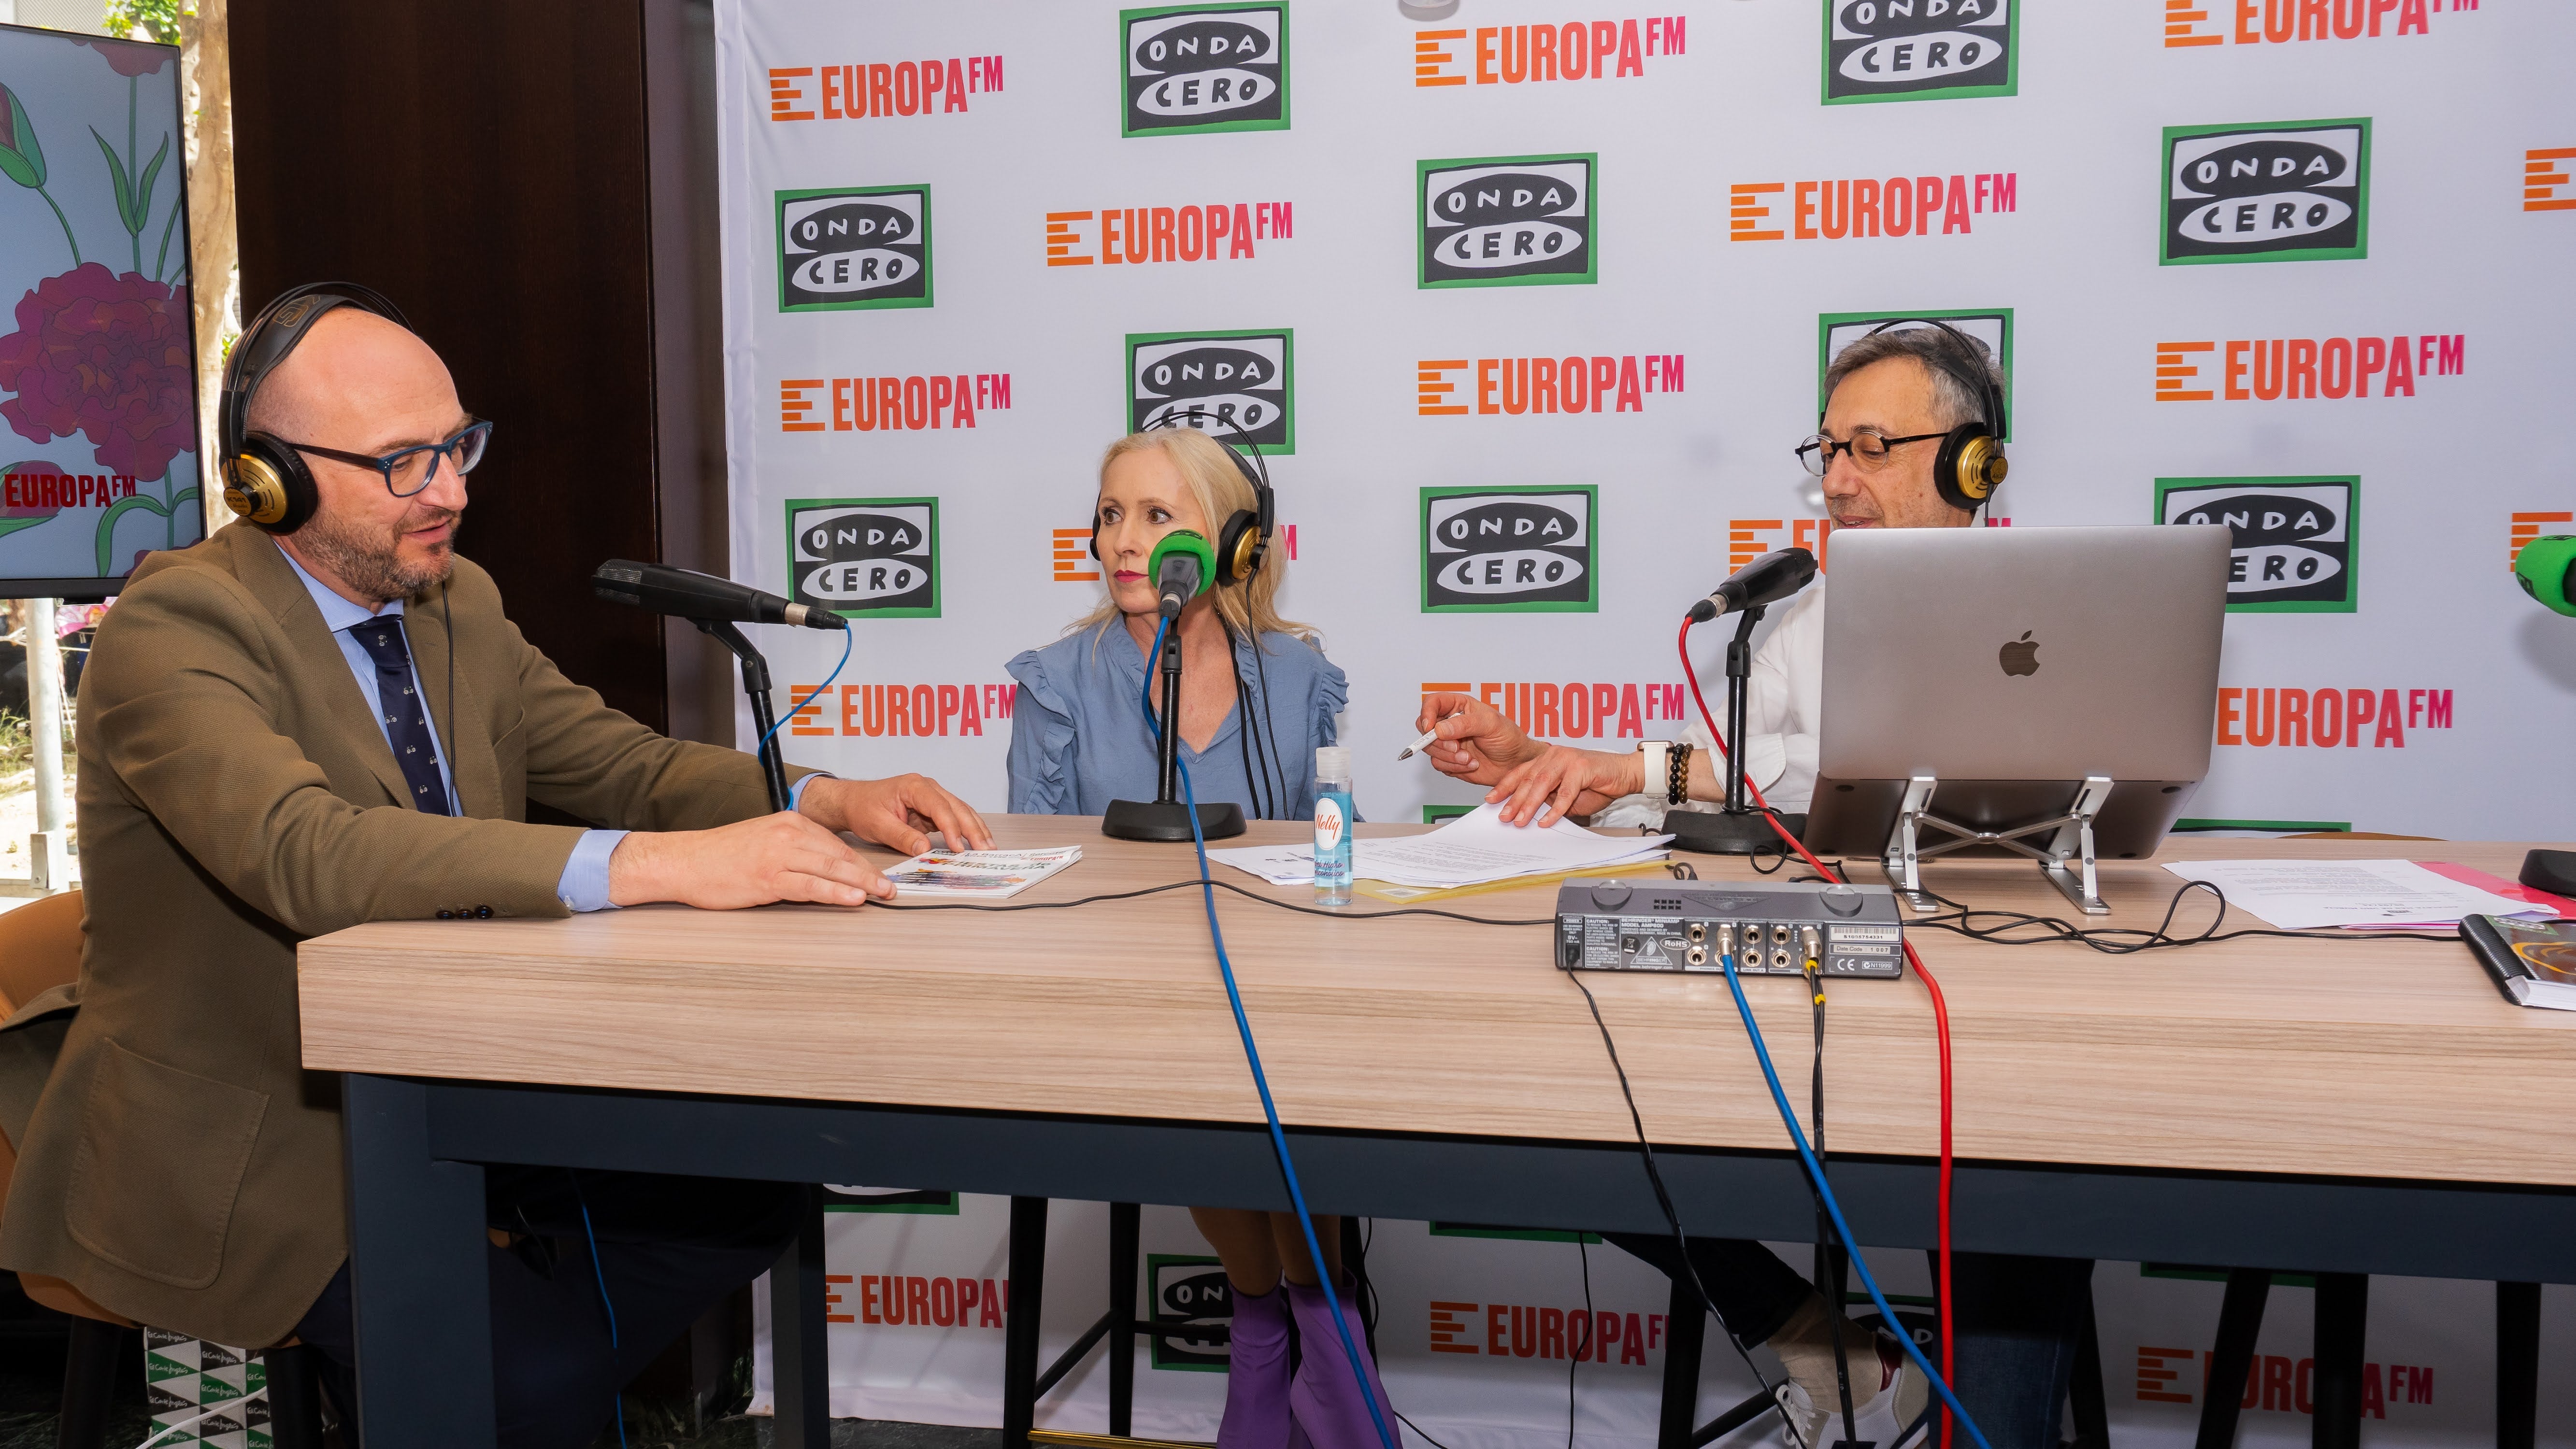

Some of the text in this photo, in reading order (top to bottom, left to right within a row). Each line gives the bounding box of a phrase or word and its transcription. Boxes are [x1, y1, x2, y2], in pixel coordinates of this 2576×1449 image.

[1856, 0, 1981, 24] ONDA
[1150, 34, 1257, 61] ONDA
[1477, 19, 1643, 84] EUROPA
[1862, 42, 1980, 72] CERO
[822, 59, 967, 119] EUROPA
[1156, 78, 1257, 107] CERO
[2197, 156, 2329, 183] ONDA
[1448, 187, 1561, 213] ONDA
[1795, 175, 1971, 239] EUROPA
[803, 217, 901, 240] ONDA
[2203, 203, 2328, 233] CERO
[1102, 204, 1254, 264] EUROPA
[1454, 231, 1562, 259] CERO
[809, 258, 902, 284] CERO
[1155, 362, 1260, 385] ONDA
[2225, 337, 2414, 400] EUROPA
[1478, 356, 1642, 414] EUROPA
[833, 375, 975, 431] EUROPA
[4, 474, 136, 508] EUROPA FM
[813, 527, 909, 549] ONDA
[1451, 518, 1562, 539] ONDA
[819, 568, 910, 592] CERO
[1457, 559, 1563, 584] CERO
[2228, 555, 2318, 582] ERO
[842, 685, 982, 737] EUROPA
[2218, 688, 2404, 748] EUROPA
[1316, 814, 1341, 840] Nelly
[861, 1275, 1002, 1328] EUROPA
[1488, 1305, 1646, 1365] EUROPA
